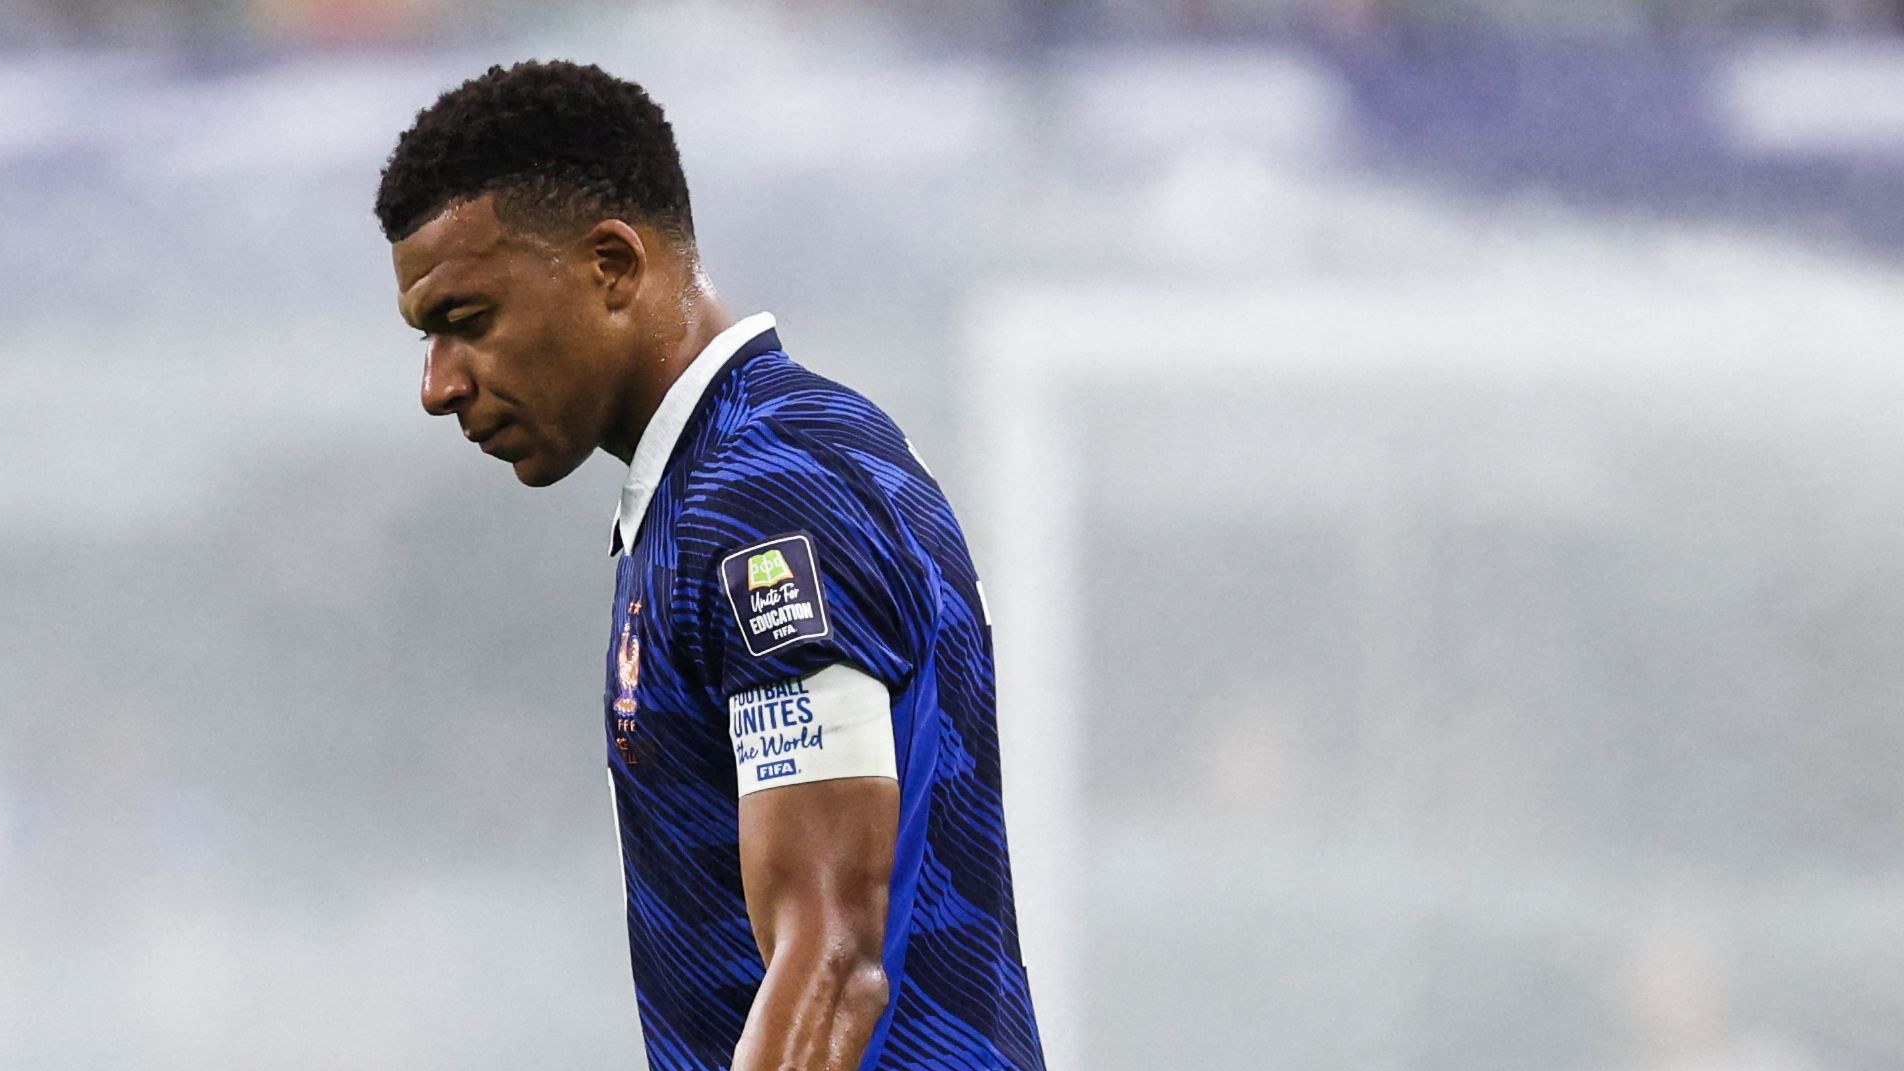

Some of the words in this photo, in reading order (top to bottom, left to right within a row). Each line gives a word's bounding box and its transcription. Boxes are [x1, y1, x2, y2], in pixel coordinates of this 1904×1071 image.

[779, 582, 800, 603] For
[749, 601, 814, 635] EDUCATION
[772, 624, 797, 640] FIFA
[733, 696, 814, 738] UNITES
[736, 740, 759, 765] the
[760, 725, 823, 757] World
[759, 762, 794, 779] FIFA
